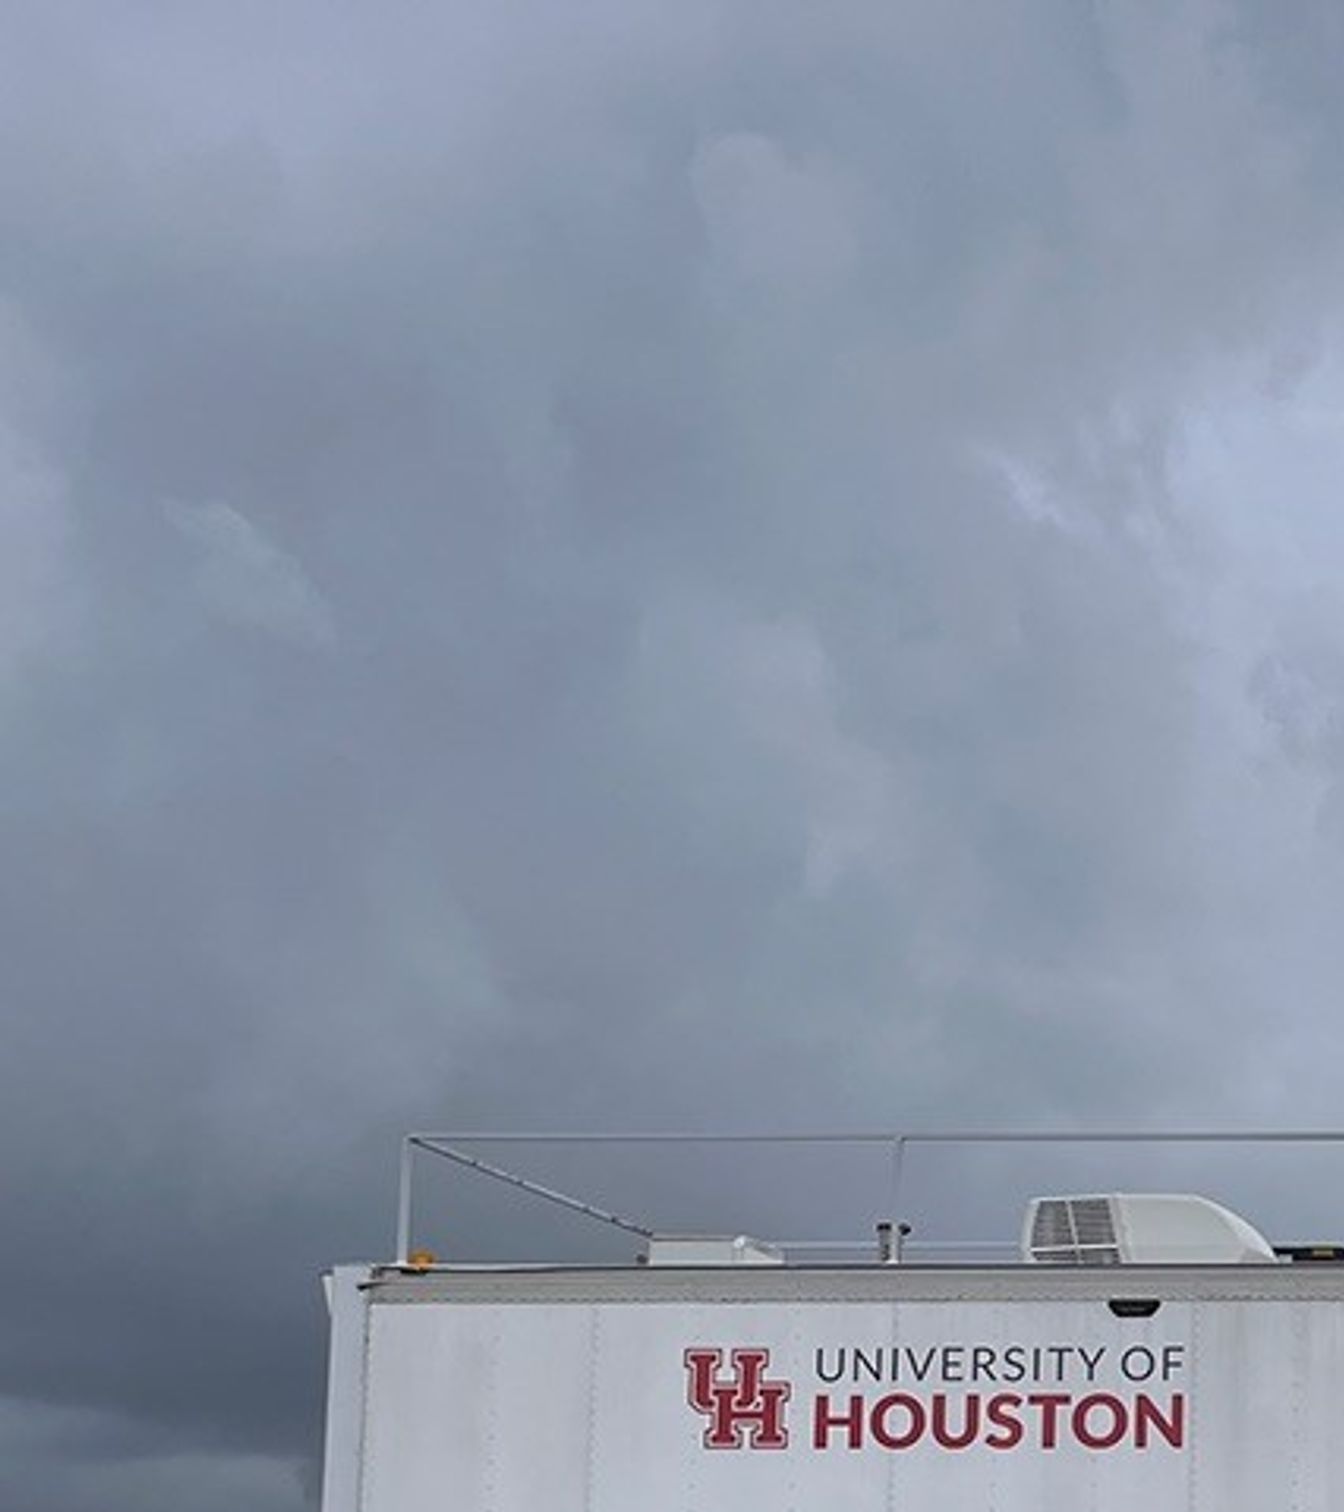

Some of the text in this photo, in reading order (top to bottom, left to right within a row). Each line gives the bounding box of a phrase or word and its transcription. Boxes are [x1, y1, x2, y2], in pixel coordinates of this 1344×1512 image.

[815, 1345, 1185, 1383] UNIVERSITY OF
[813, 1393, 1185, 1451] HOUSTON
